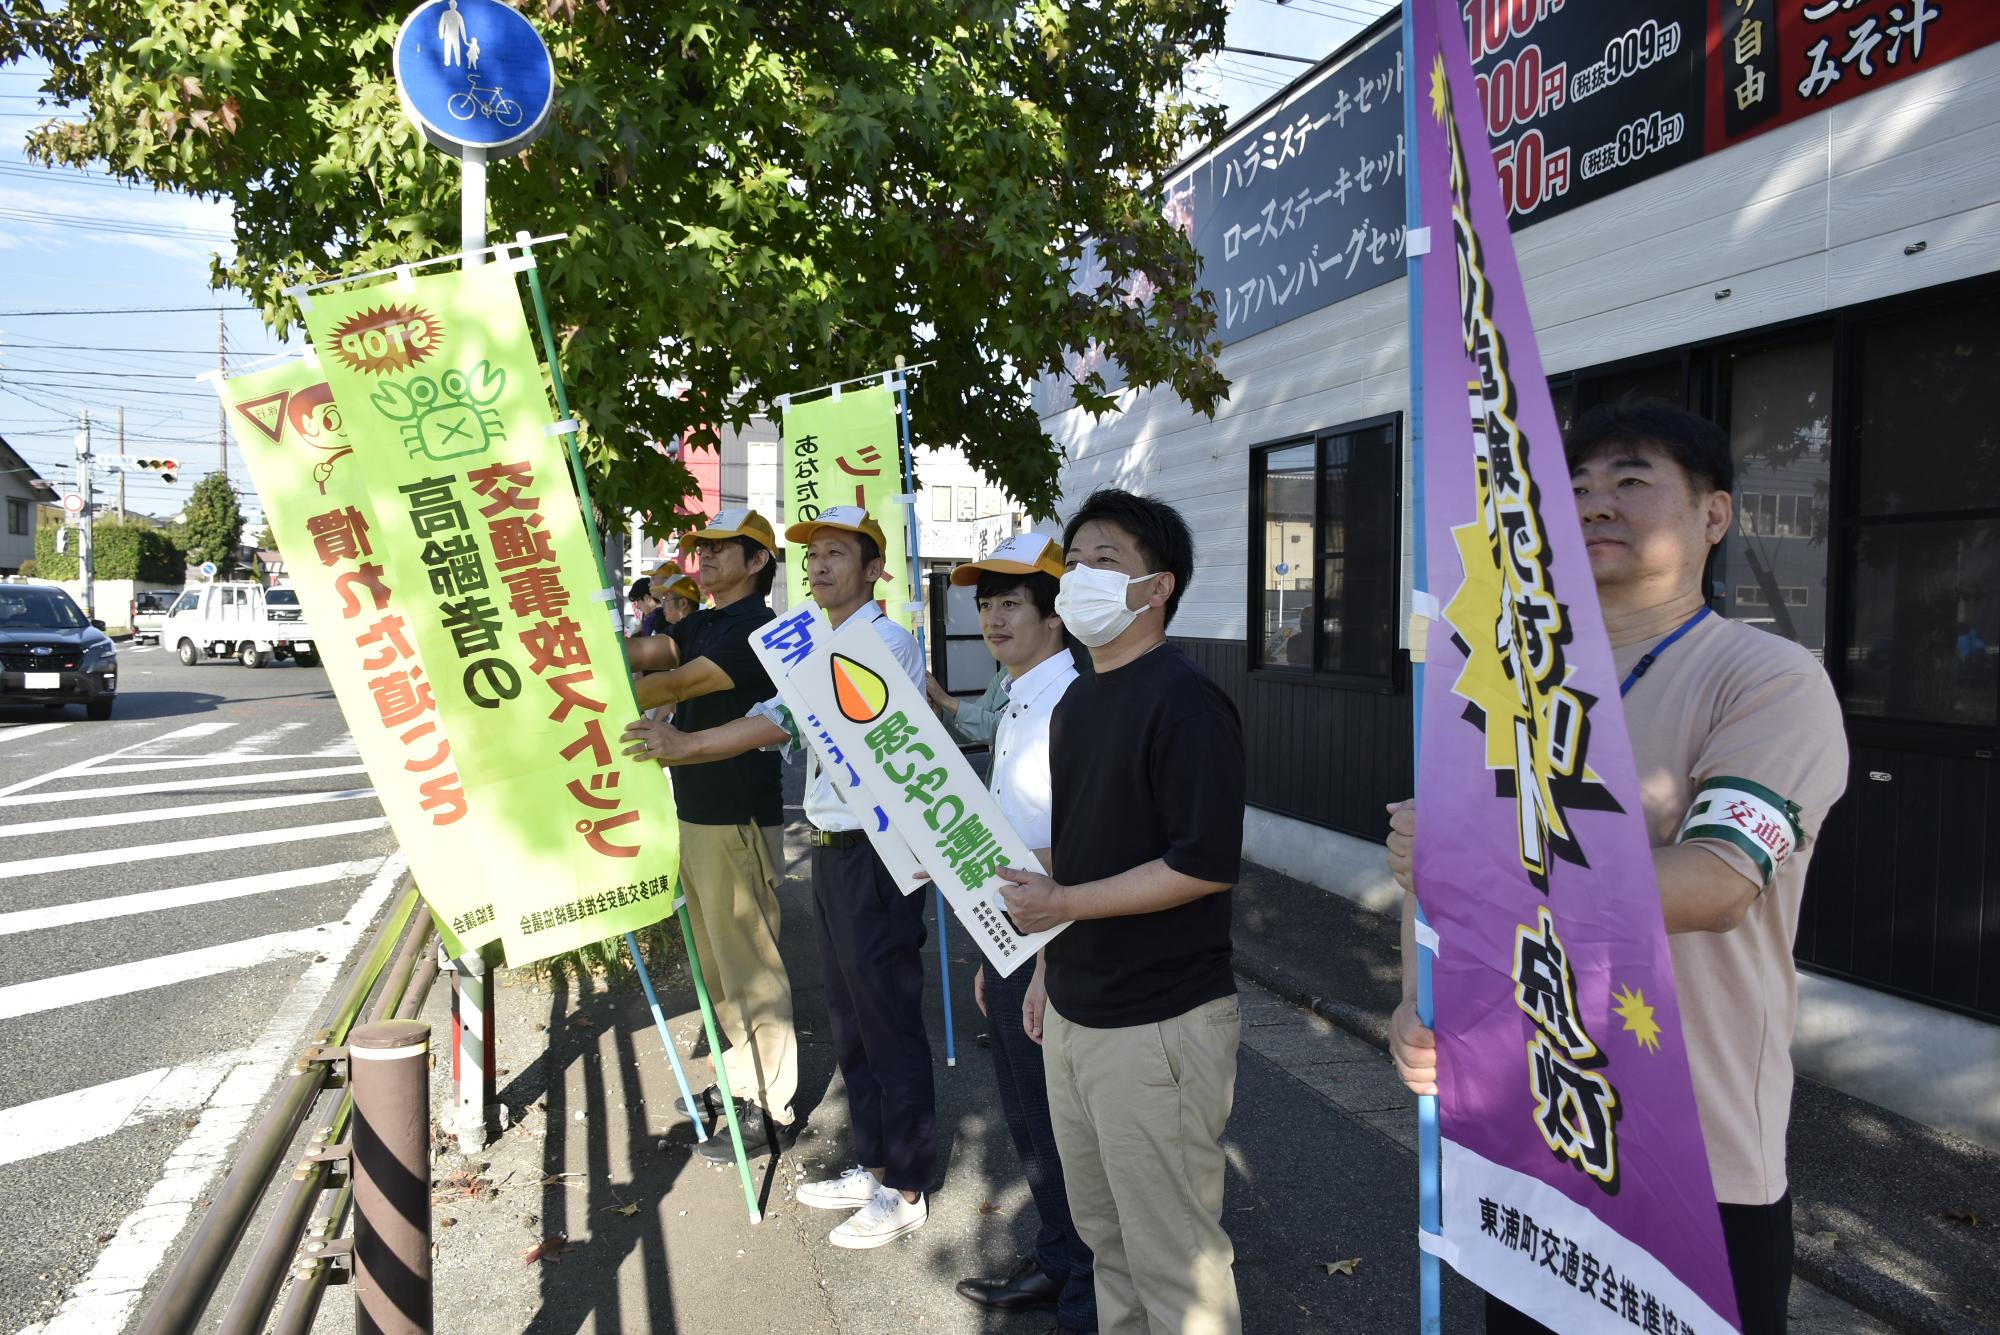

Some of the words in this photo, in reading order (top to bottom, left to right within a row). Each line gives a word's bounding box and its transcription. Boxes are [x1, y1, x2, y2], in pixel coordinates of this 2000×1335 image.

[1798, 0, 1938, 98] みそ汁
[864, 710, 1011, 892] 思いやり運転
